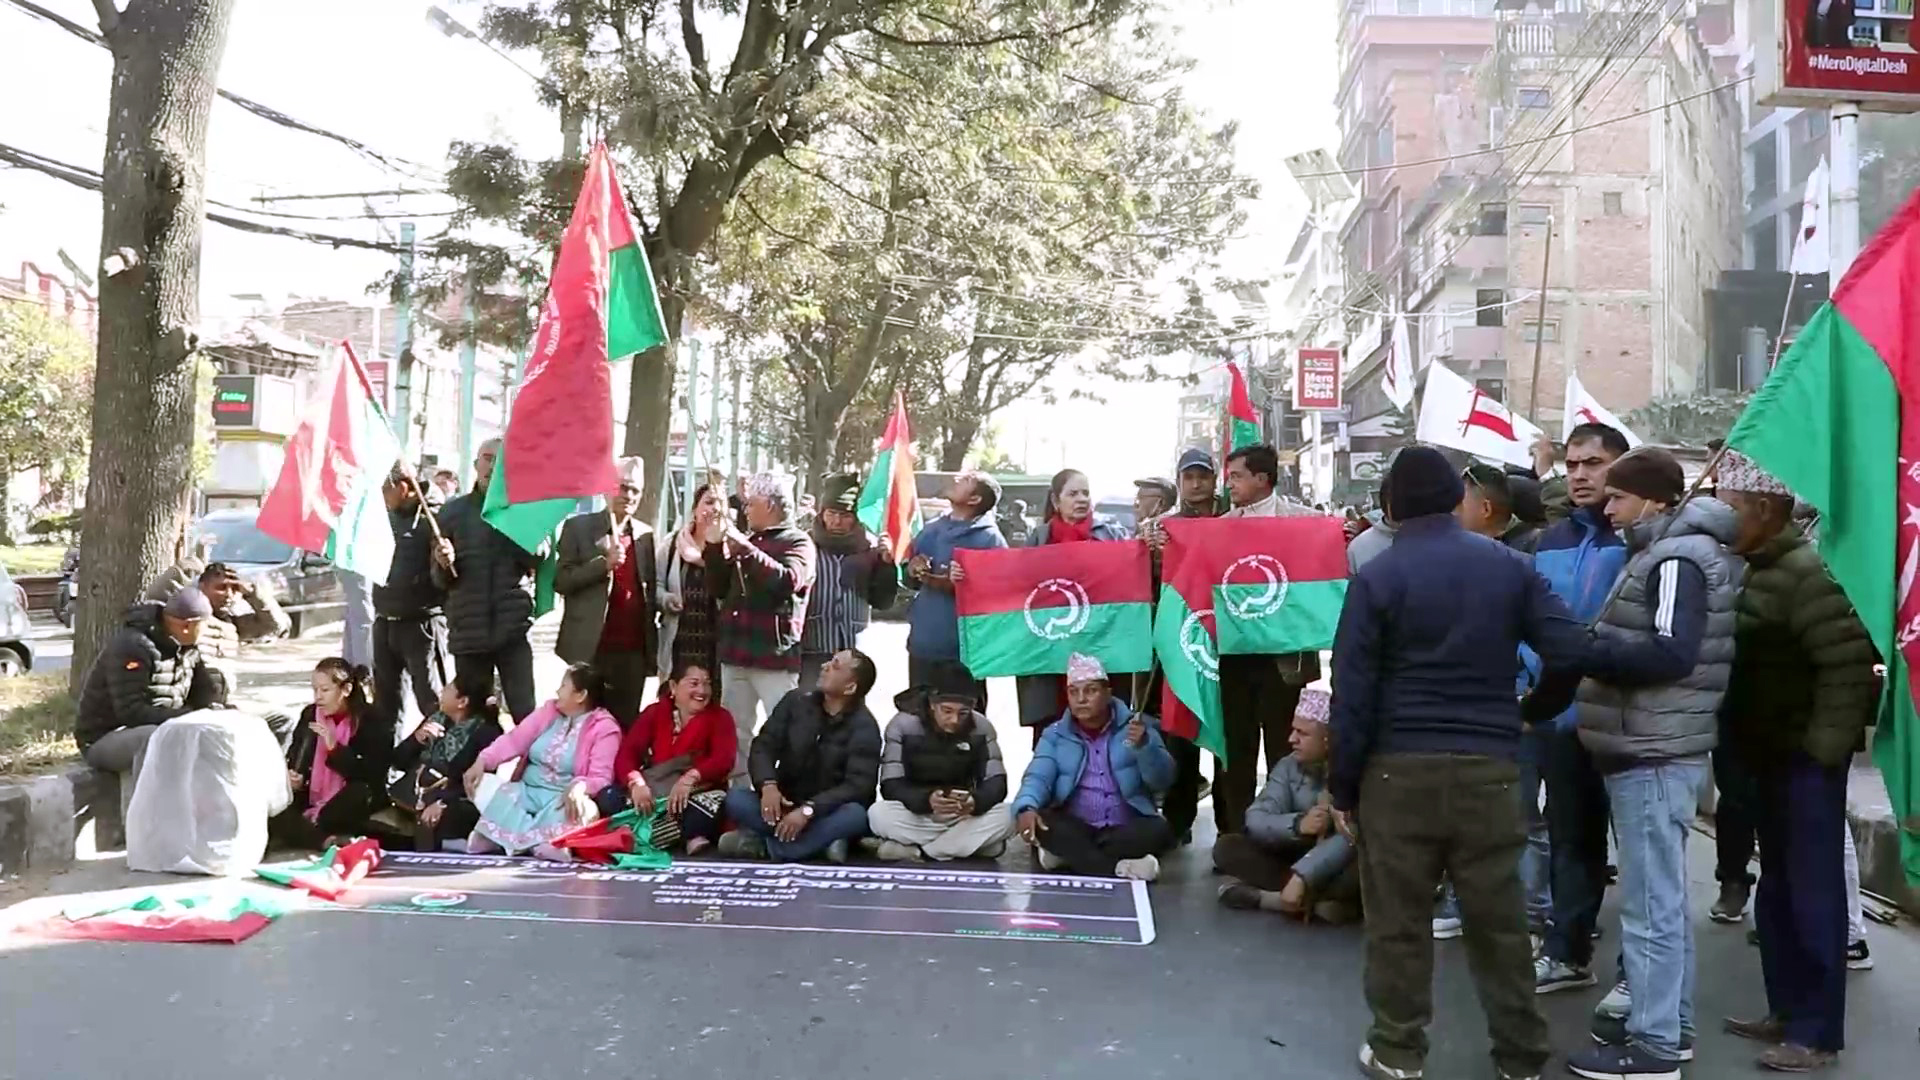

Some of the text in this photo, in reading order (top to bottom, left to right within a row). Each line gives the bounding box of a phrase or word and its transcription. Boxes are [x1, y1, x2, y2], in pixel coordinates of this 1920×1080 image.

[1808, 54, 1907, 75] #MeroDigitalDesh
[1304, 372, 1334, 383] Mero
[1304, 389, 1334, 399] Desh
